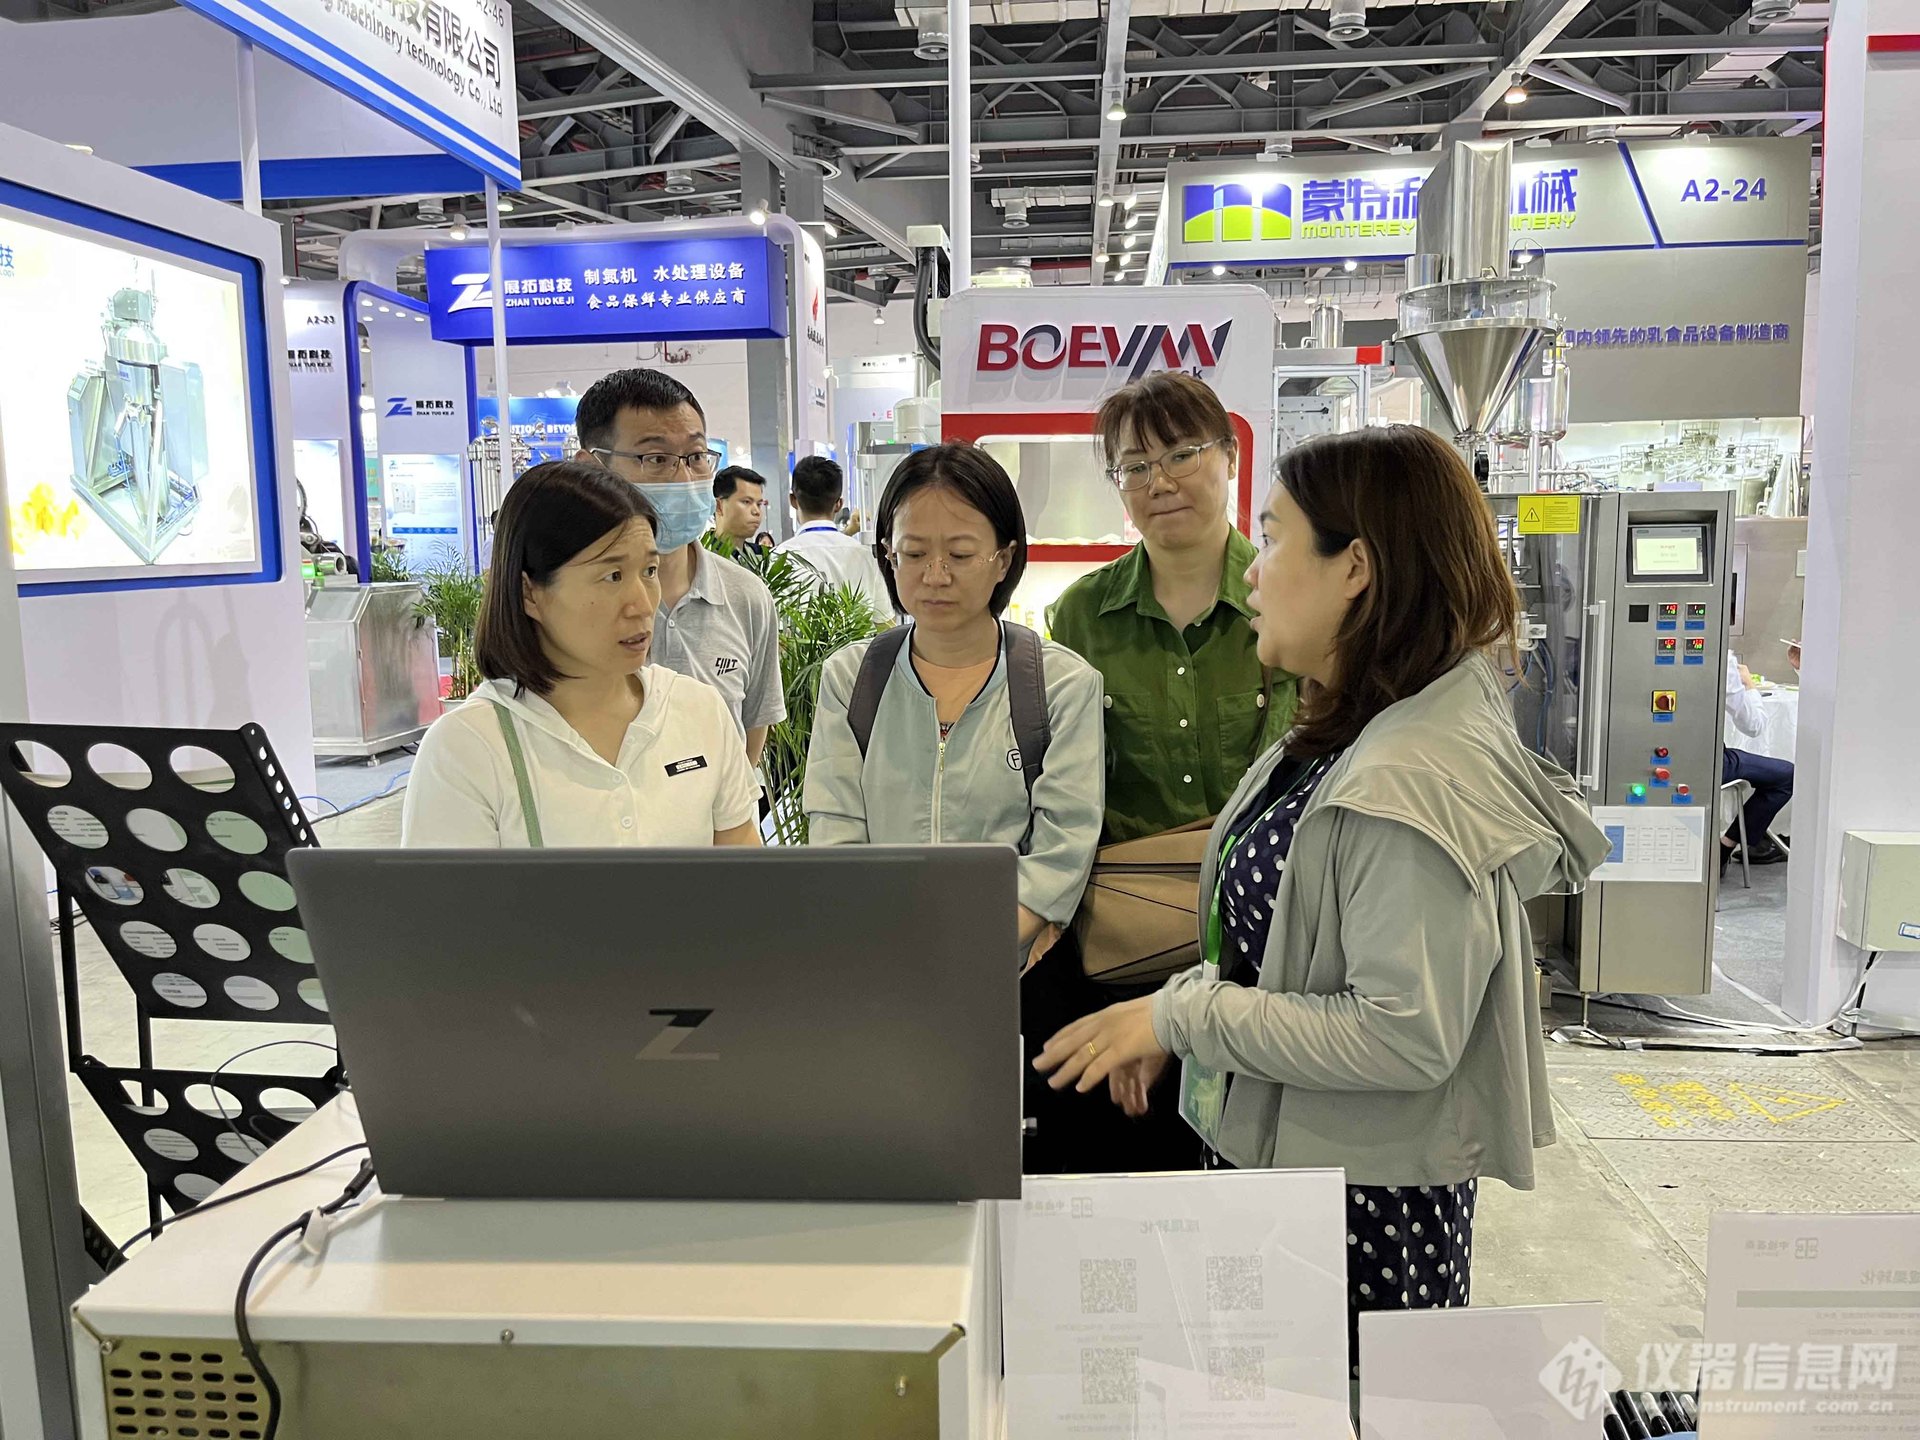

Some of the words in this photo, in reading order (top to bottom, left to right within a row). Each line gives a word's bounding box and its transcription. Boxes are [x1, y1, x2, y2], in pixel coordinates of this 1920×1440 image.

[406, 36, 466, 96] technology
[1680, 178, 1767, 202] A2-24
[1301, 220, 1416, 240] MONTEREY
[584, 267, 638, 286] 制氮机
[653, 261, 746, 284] 水处理设备
[504, 277, 573, 296] 展拓科技
[505, 297, 531, 308] ZHAN
[532, 296, 552, 306] TUO
[552, 295, 565, 305] KE
[565, 295, 575, 305] JI
[586, 286, 747, 311] 食品保鲜专业供应商
[307, 316, 336, 325] A2-23
[1564, 323, 1790, 346] 国内领先的乳食品设备制造商
